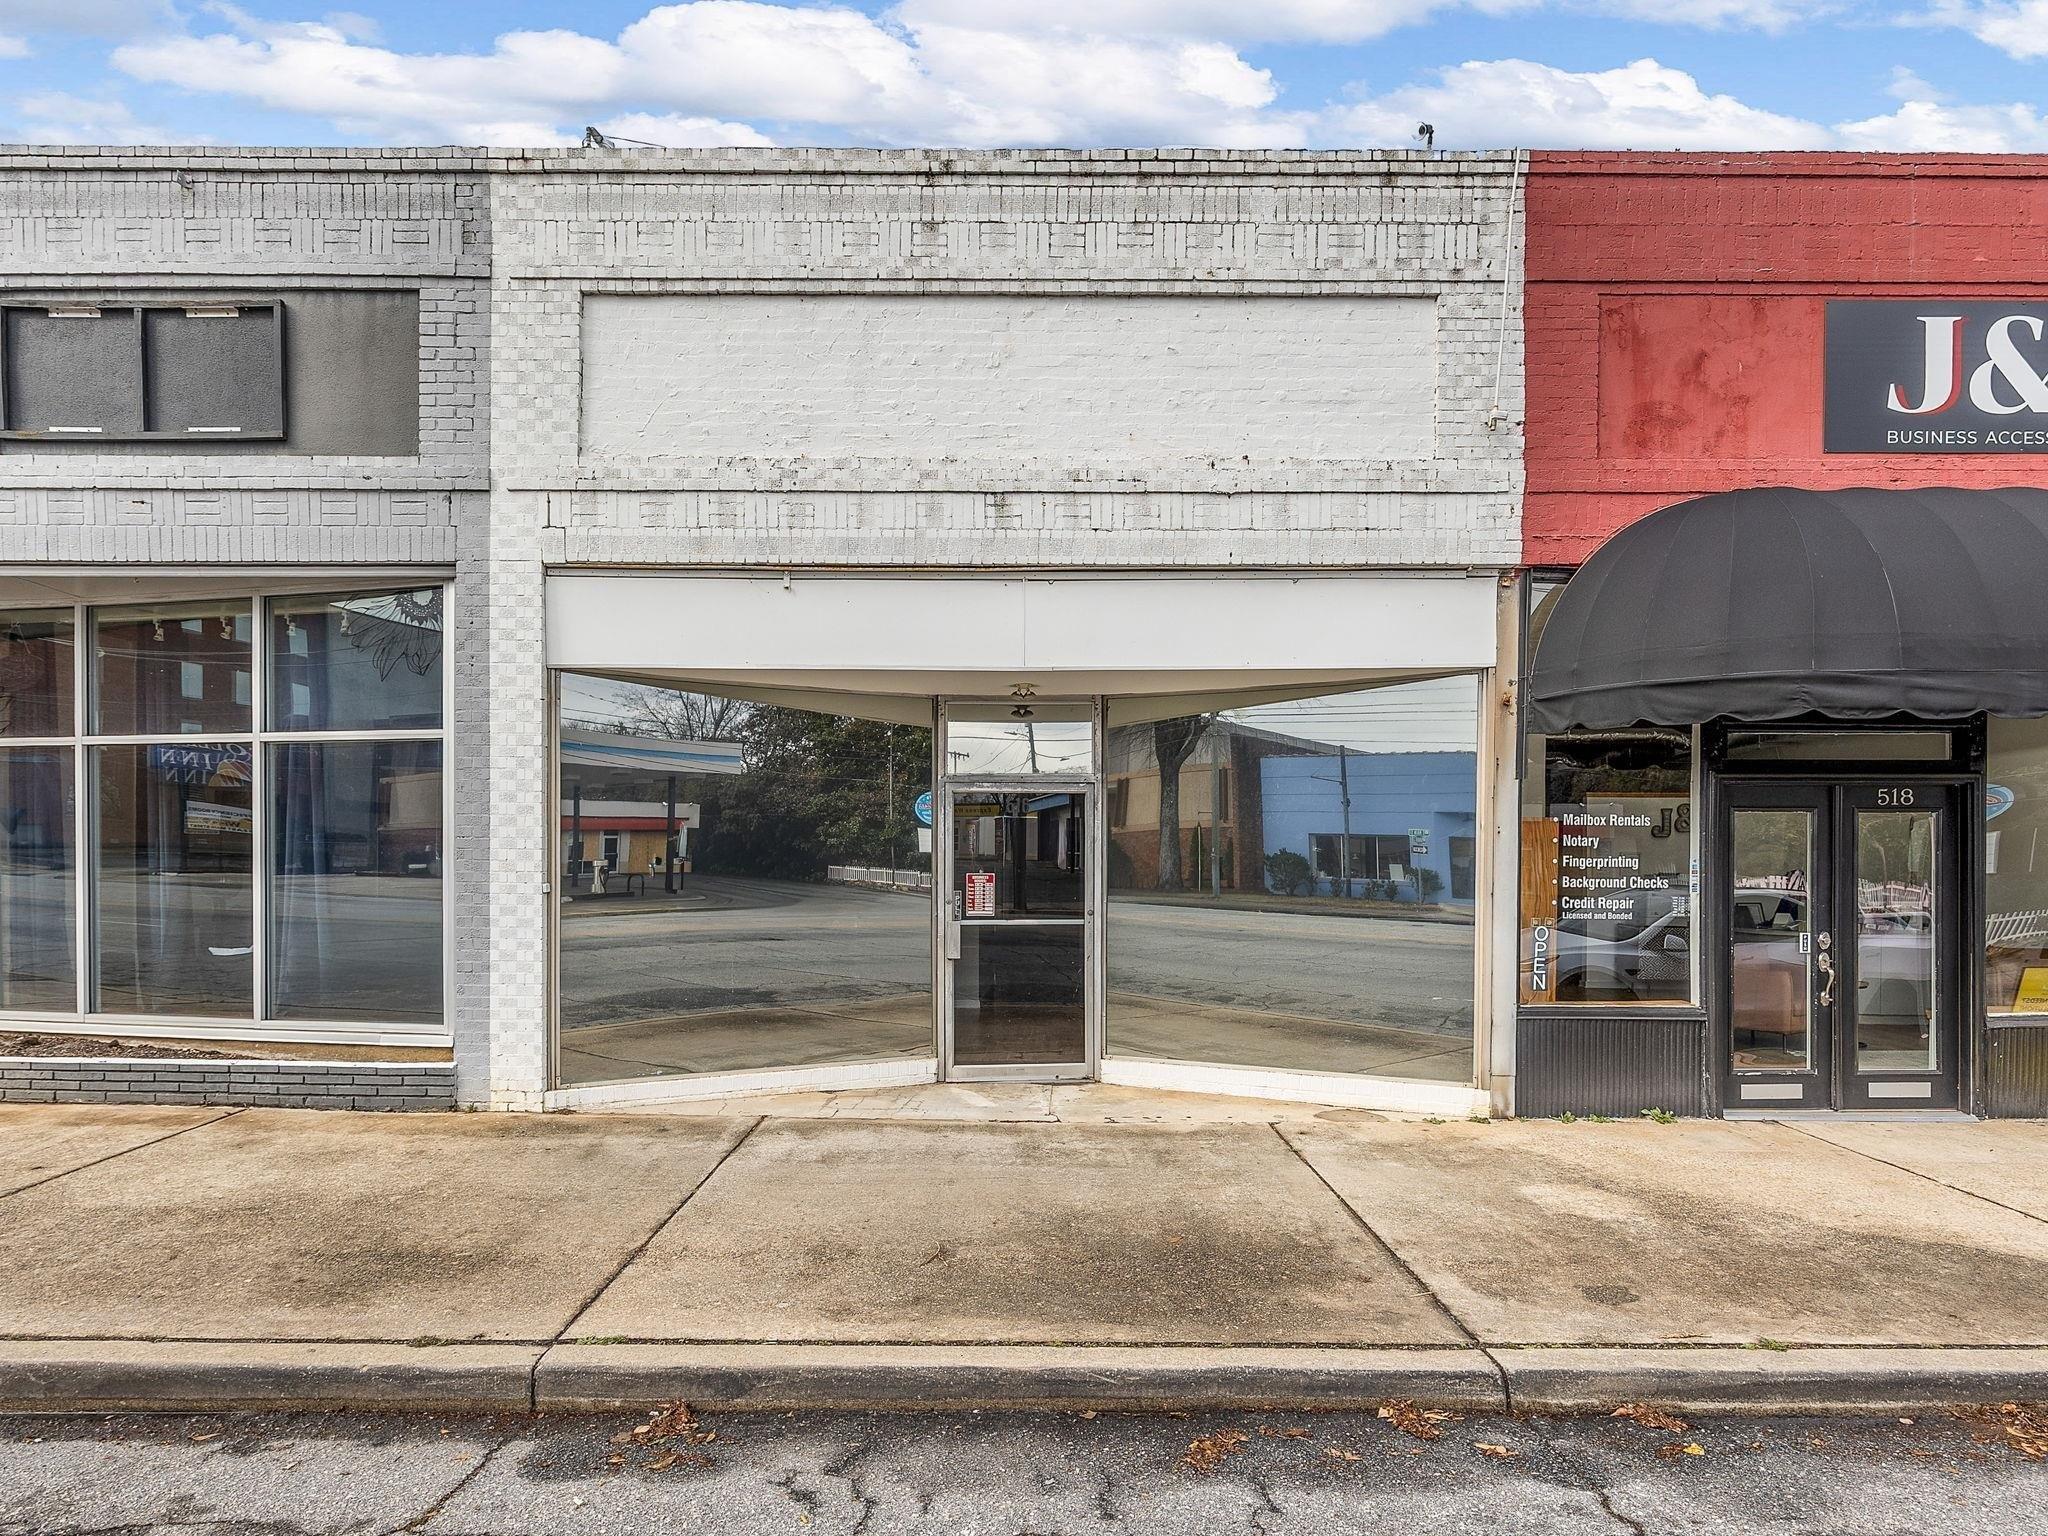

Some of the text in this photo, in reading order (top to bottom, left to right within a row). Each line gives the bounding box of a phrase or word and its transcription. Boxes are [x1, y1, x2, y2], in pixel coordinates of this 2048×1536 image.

[1887, 431, 2048, 445] BUSINESS ACCES
[1877, 788, 1914, 806] 518
[1563, 814, 1651, 827] Mailbox Rentals
[1562, 835, 1599, 849] Notary
[1562, 855, 1639, 869] Fingerprinting
[1562, 876, 1669, 890] Background Checks
[1562, 896, 1634, 911] Credit Repair
[1562, 911, 1633, 920] Licensed and Bonded
[1533, 926, 1549, 990] OPEN
